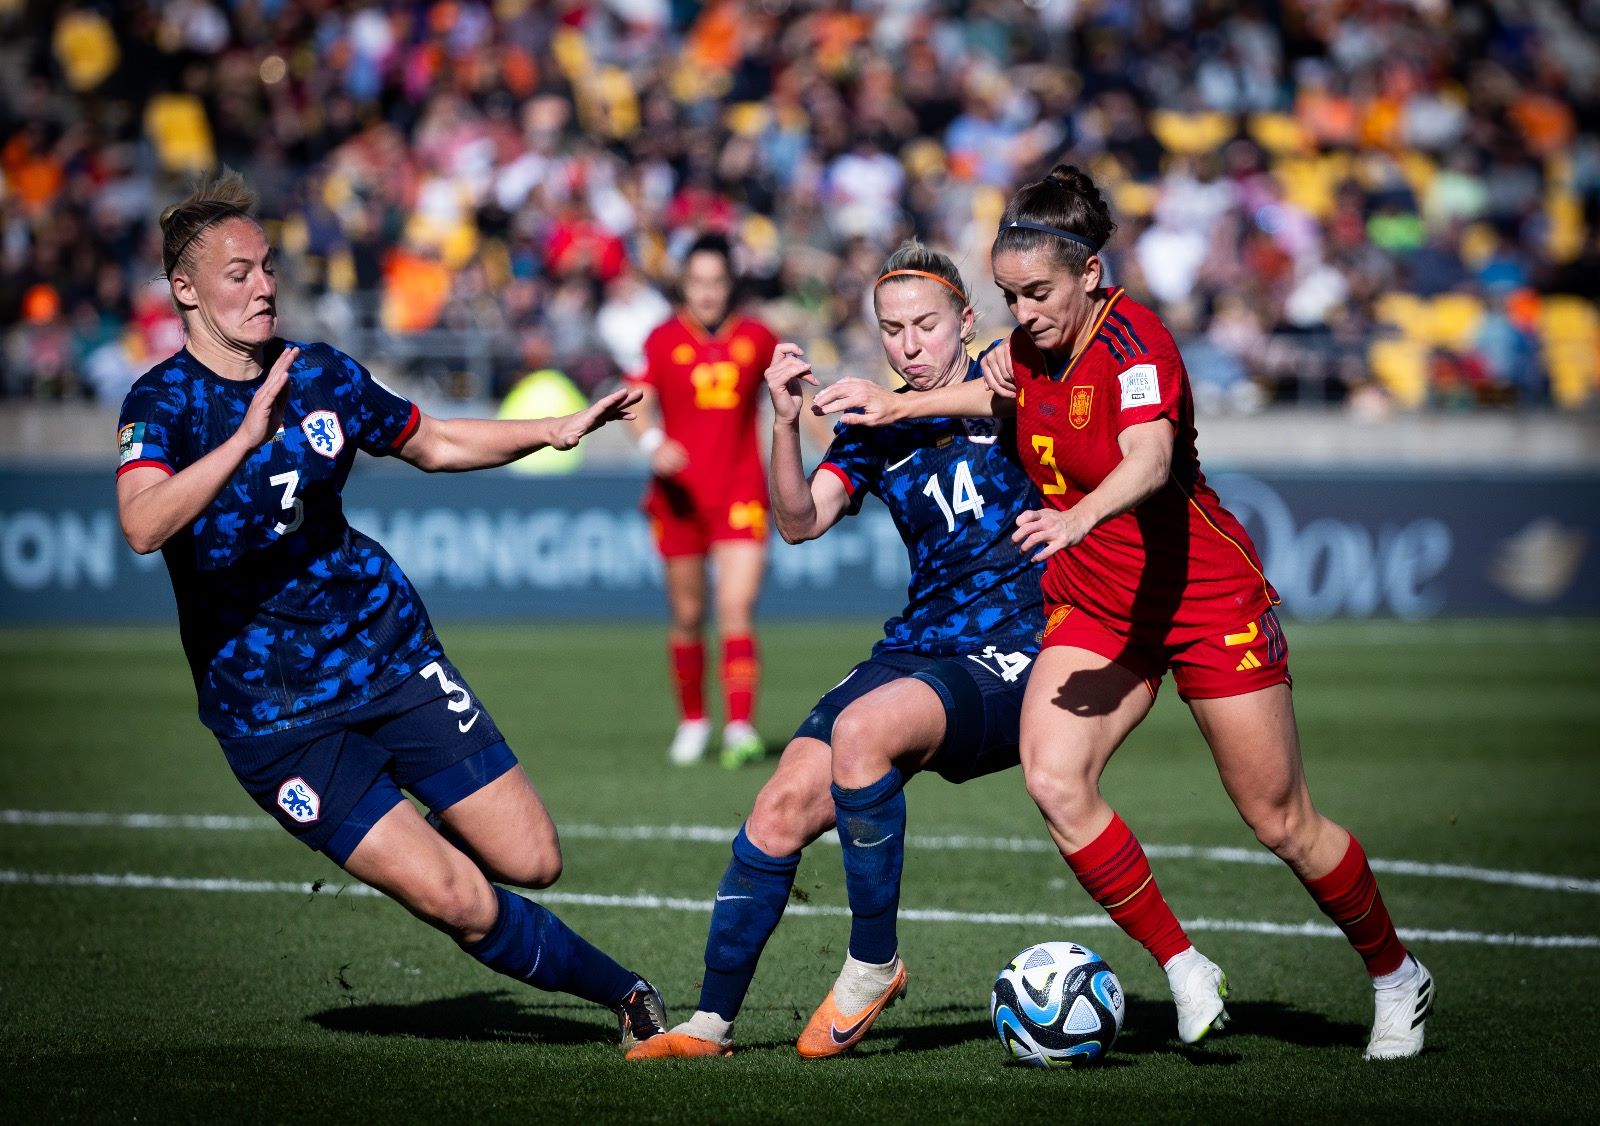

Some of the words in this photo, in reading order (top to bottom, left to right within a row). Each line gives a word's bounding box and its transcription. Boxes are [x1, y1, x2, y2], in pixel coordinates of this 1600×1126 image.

[922, 460, 985, 533] 14
[1031, 434, 1067, 495] 3
[269, 470, 304, 535] 3
[0, 510, 115, 589] ON
[419, 661, 471, 713] 3
